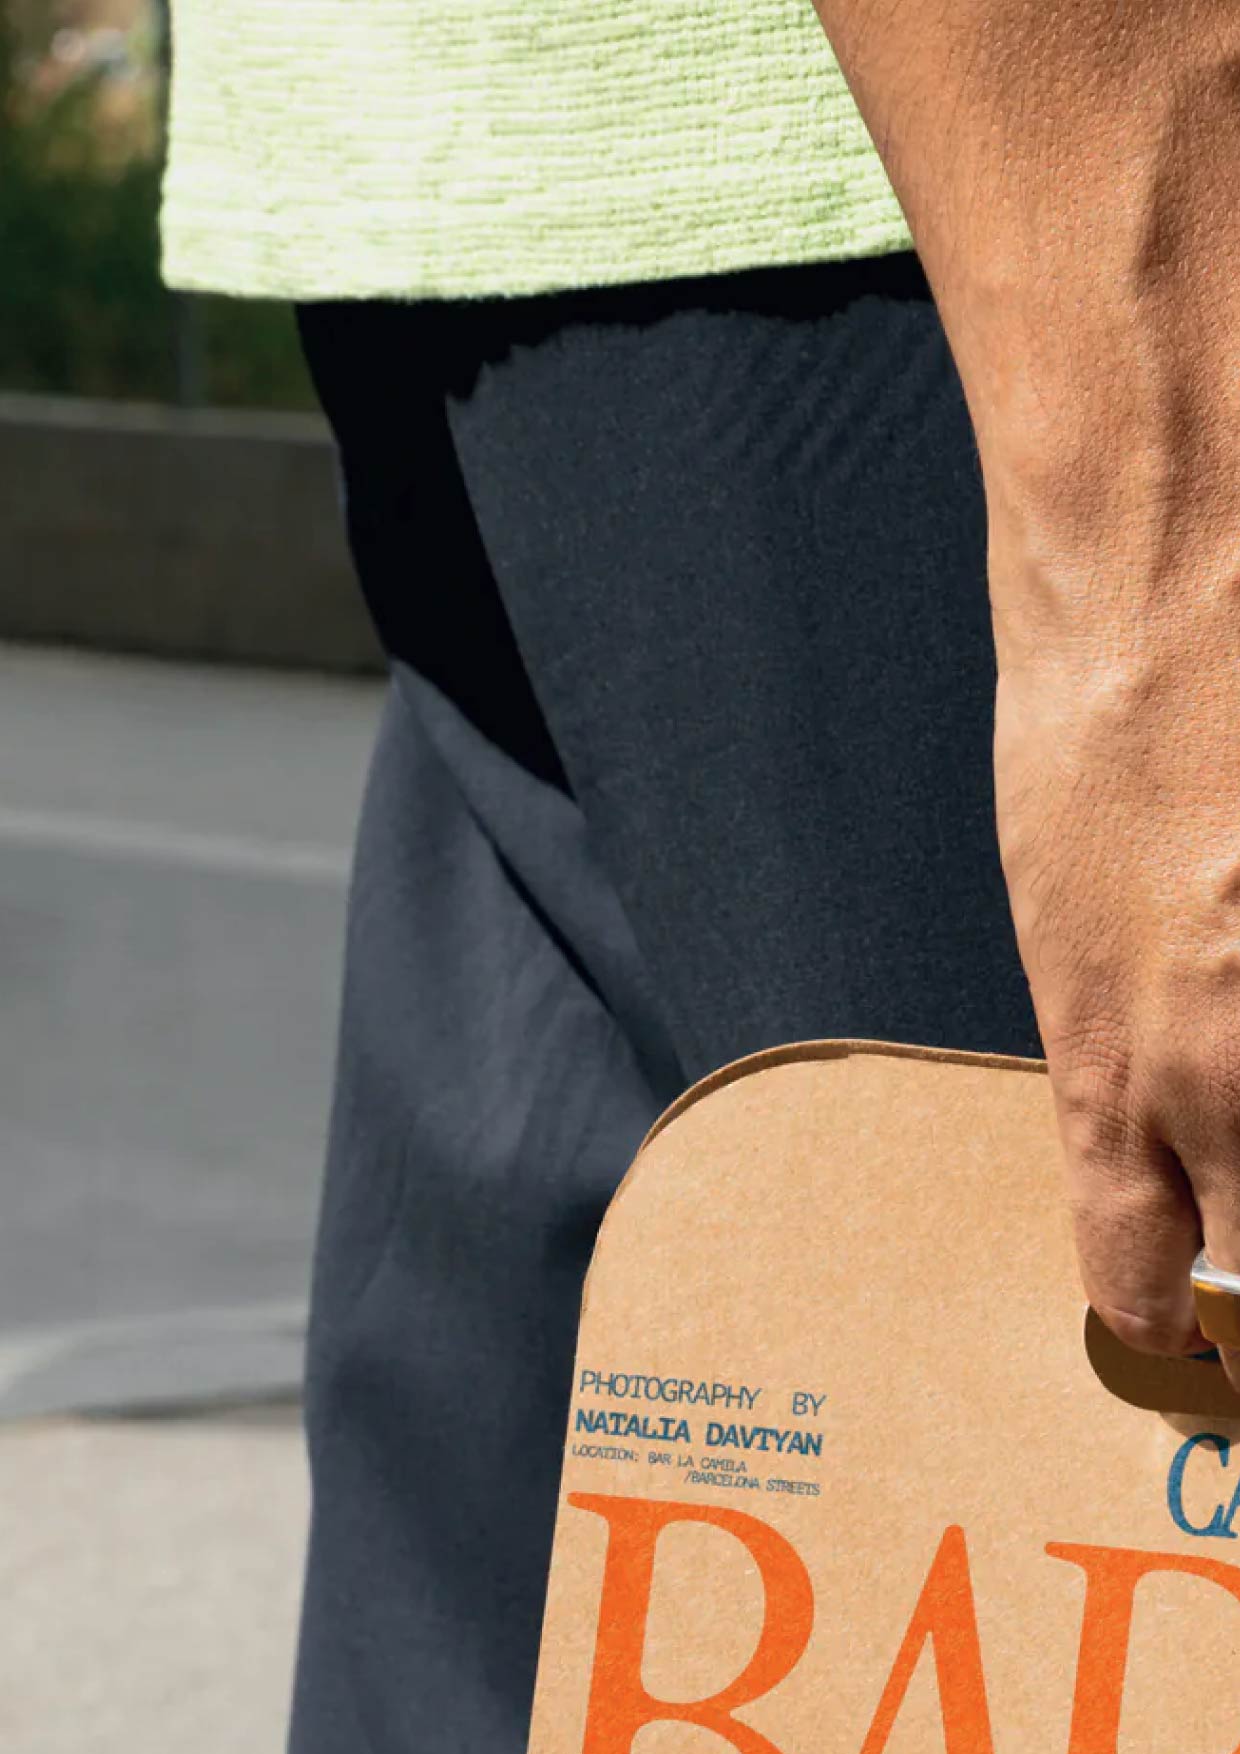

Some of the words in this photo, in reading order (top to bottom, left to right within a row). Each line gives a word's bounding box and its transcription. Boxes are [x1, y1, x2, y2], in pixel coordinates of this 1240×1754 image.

[579, 1369, 762, 1410] PHOTOGRAPHY
[791, 1391, 827, 1417] BY
[574, 1408, 692, 1444] NATALIA
[705, 1422, 824, 1457] DAVTYAN
[572, 1443, 640, 1463] LOCATION:
[647, 1451, 673, 1466] BAR
[677, 1454, 695, 1468] LA
[766, 1479, 821, 1496] STREETS
